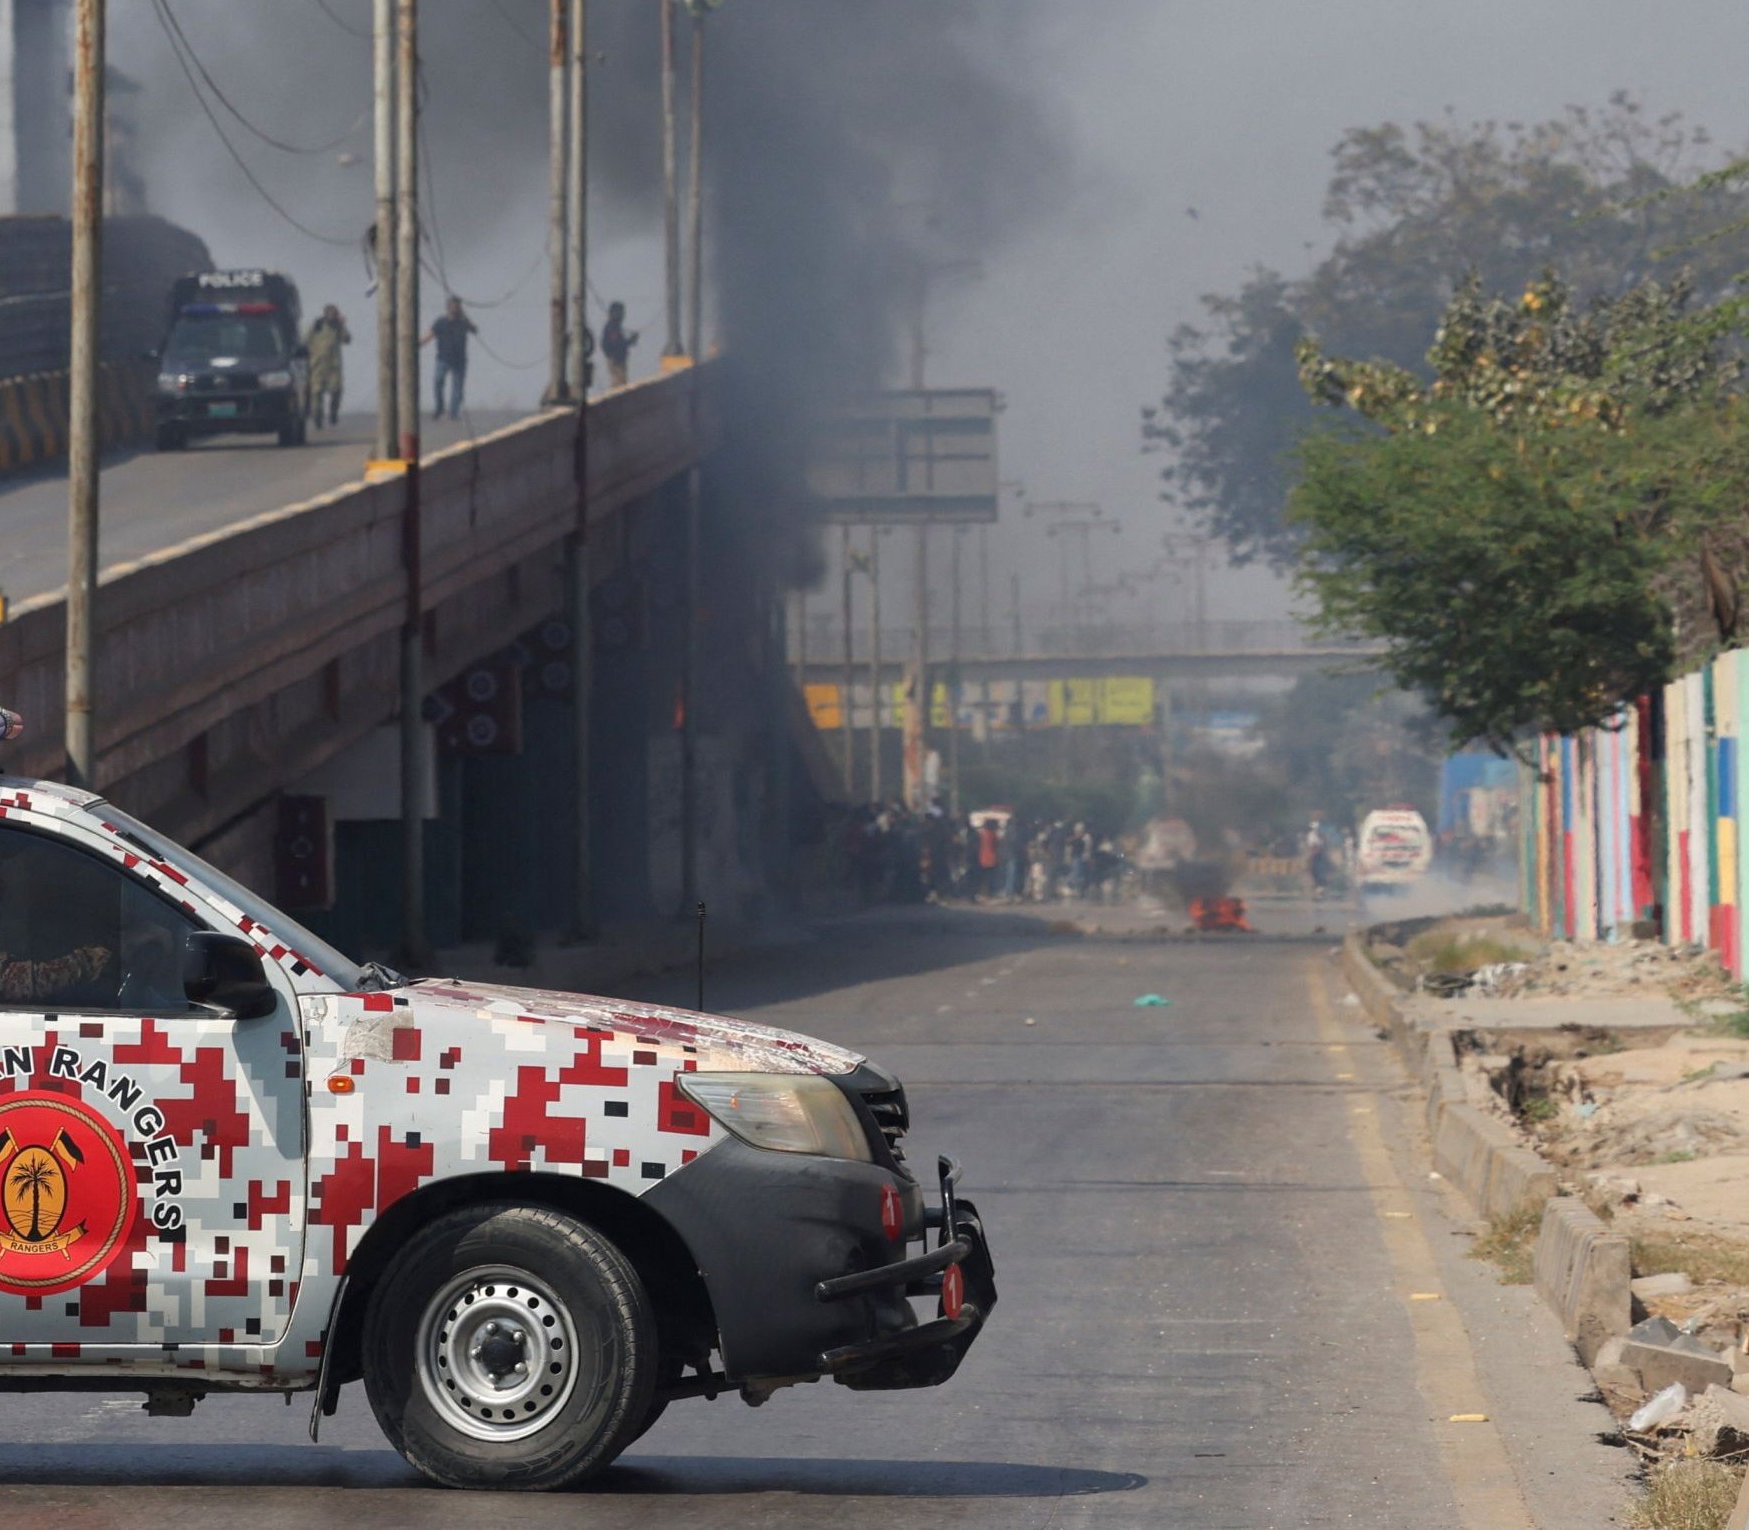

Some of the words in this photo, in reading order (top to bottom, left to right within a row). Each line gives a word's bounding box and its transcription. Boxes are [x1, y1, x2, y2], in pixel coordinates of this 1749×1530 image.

[199, 271, 265, 288] POLICE
[50, 1047, 183, 1230] RANGERS
[10, 1241, 59, 1253] RANGERS
